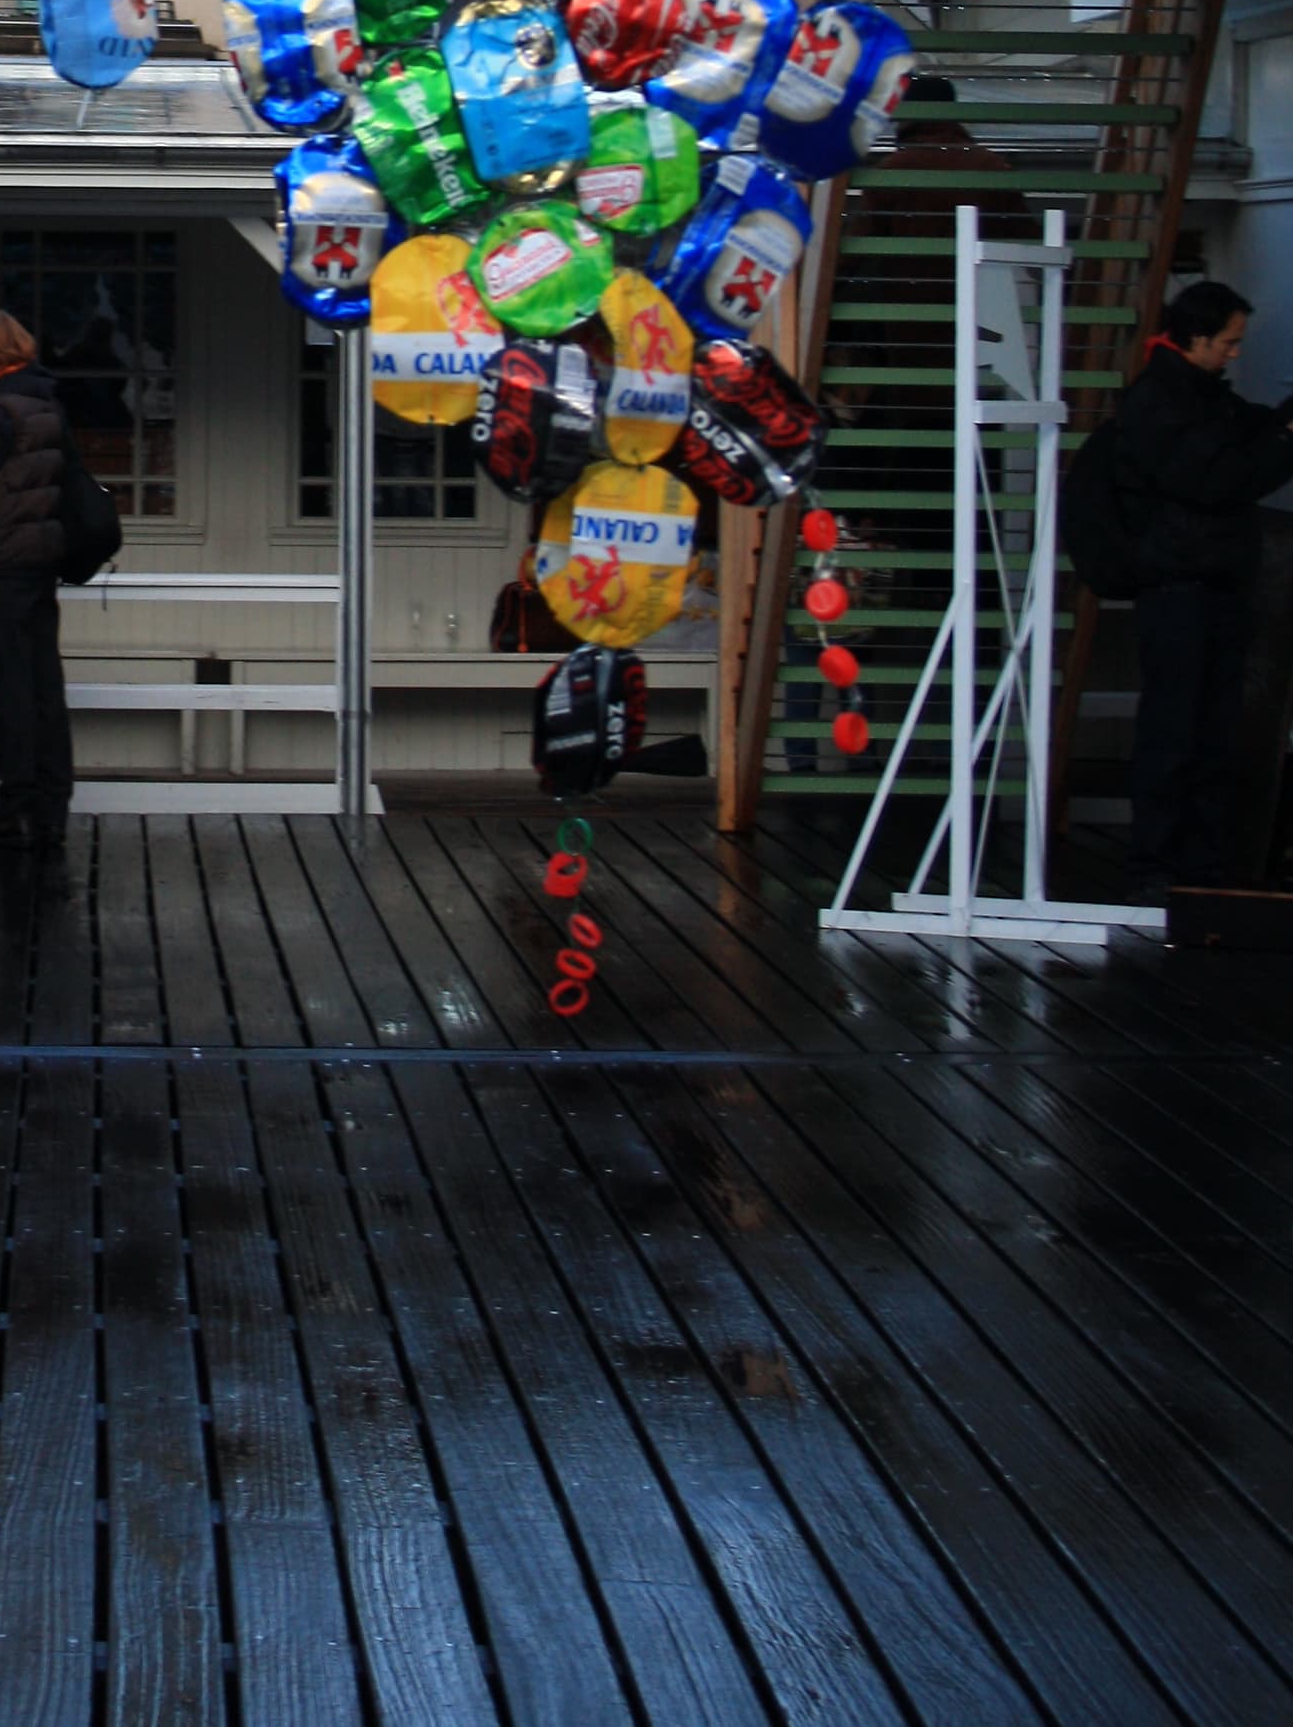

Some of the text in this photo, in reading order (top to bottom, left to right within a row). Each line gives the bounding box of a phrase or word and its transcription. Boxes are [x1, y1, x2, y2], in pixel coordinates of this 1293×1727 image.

[394, 79, 472, 208] Heineken
[471, 376, 496, 444] zero
[691, 407, 745, 464] zero
[604, 700, 626, 762] zero
